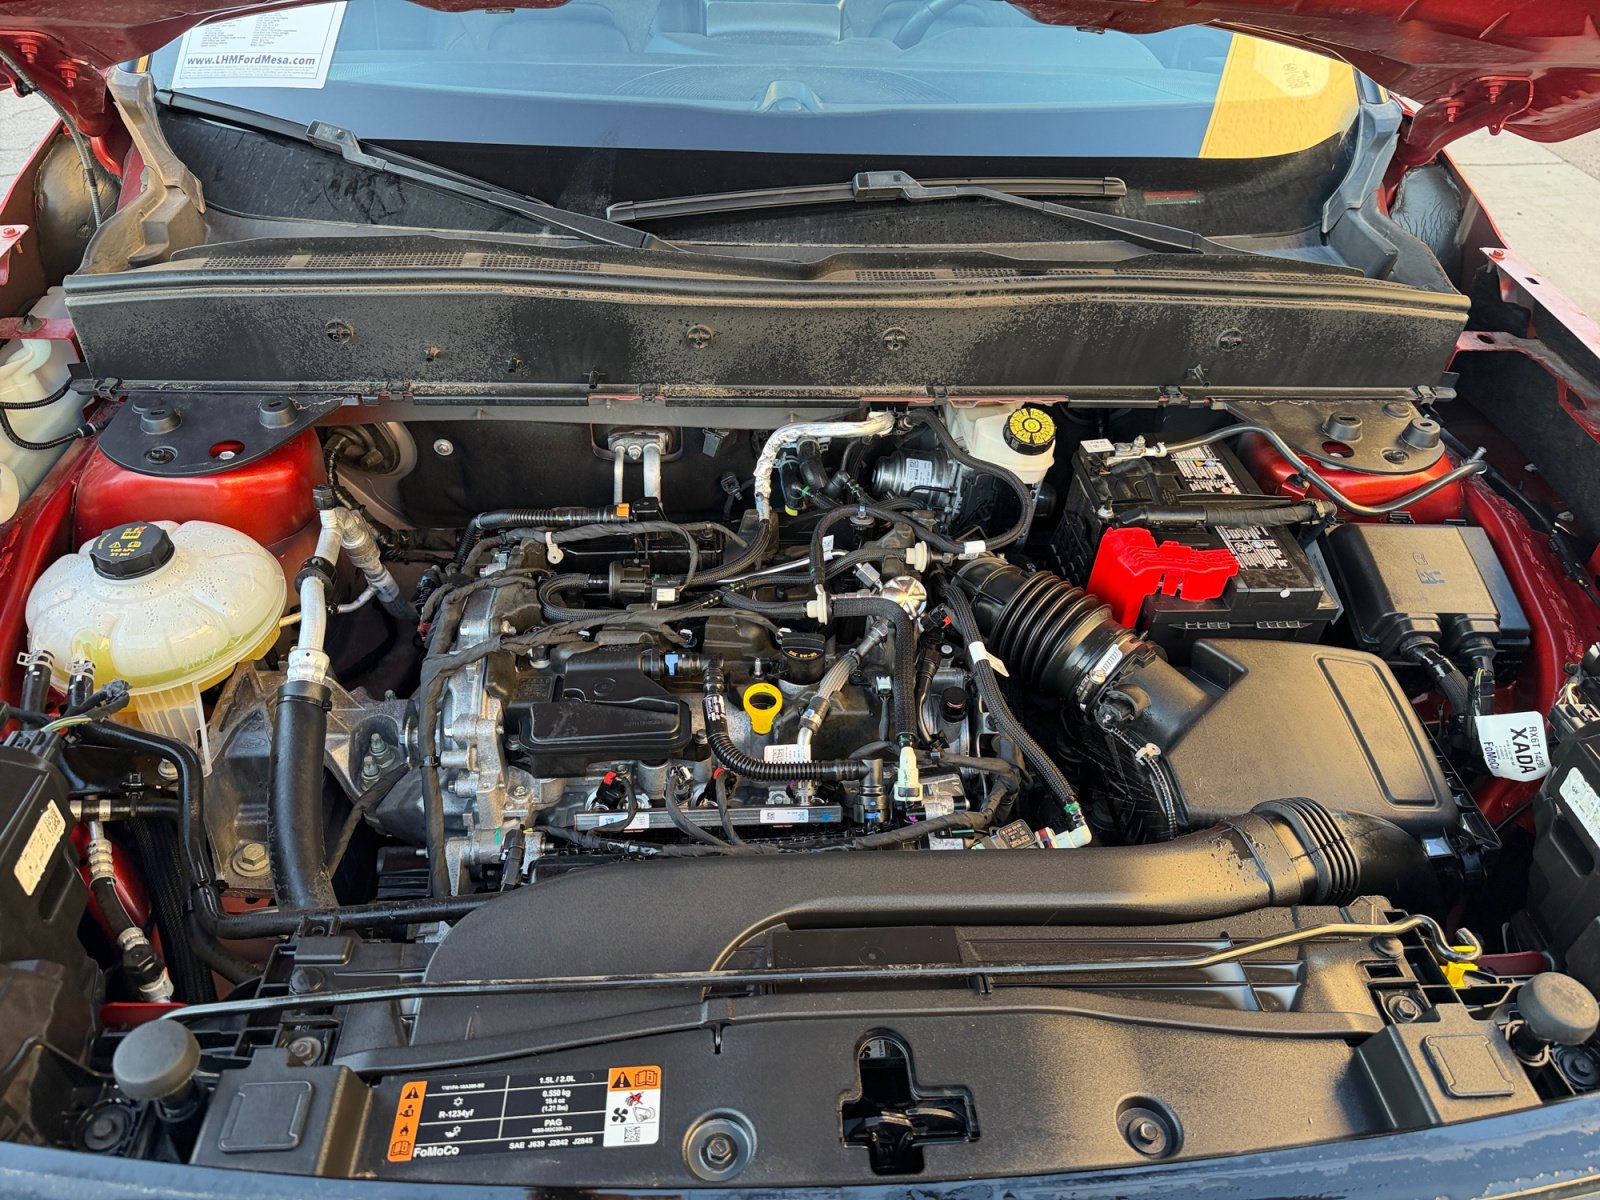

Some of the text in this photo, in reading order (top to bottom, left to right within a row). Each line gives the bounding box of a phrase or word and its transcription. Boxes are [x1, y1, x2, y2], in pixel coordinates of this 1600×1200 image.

[187, 55, 316, 65] www.LHMFordMesa.com
[1529, 726, 1541, 748] RX6T
[1483, 741, 1500, 770] FoMoCo
[1510, 727, 1537, 774] XADA
[539, 1076, 555, 1084] 1.5L
[560, 1075, 576, 1083] 2.0L
[561, 1089, 572, 1097] kg
[438, 1108, 475, 1119] R-1234yf
[544, 1118, 563, 1127] PAG
[508, 1137, 594, 1149] SAE J639 J2842 J2845
[413, 1145, 460, 1158] FoMoCo
